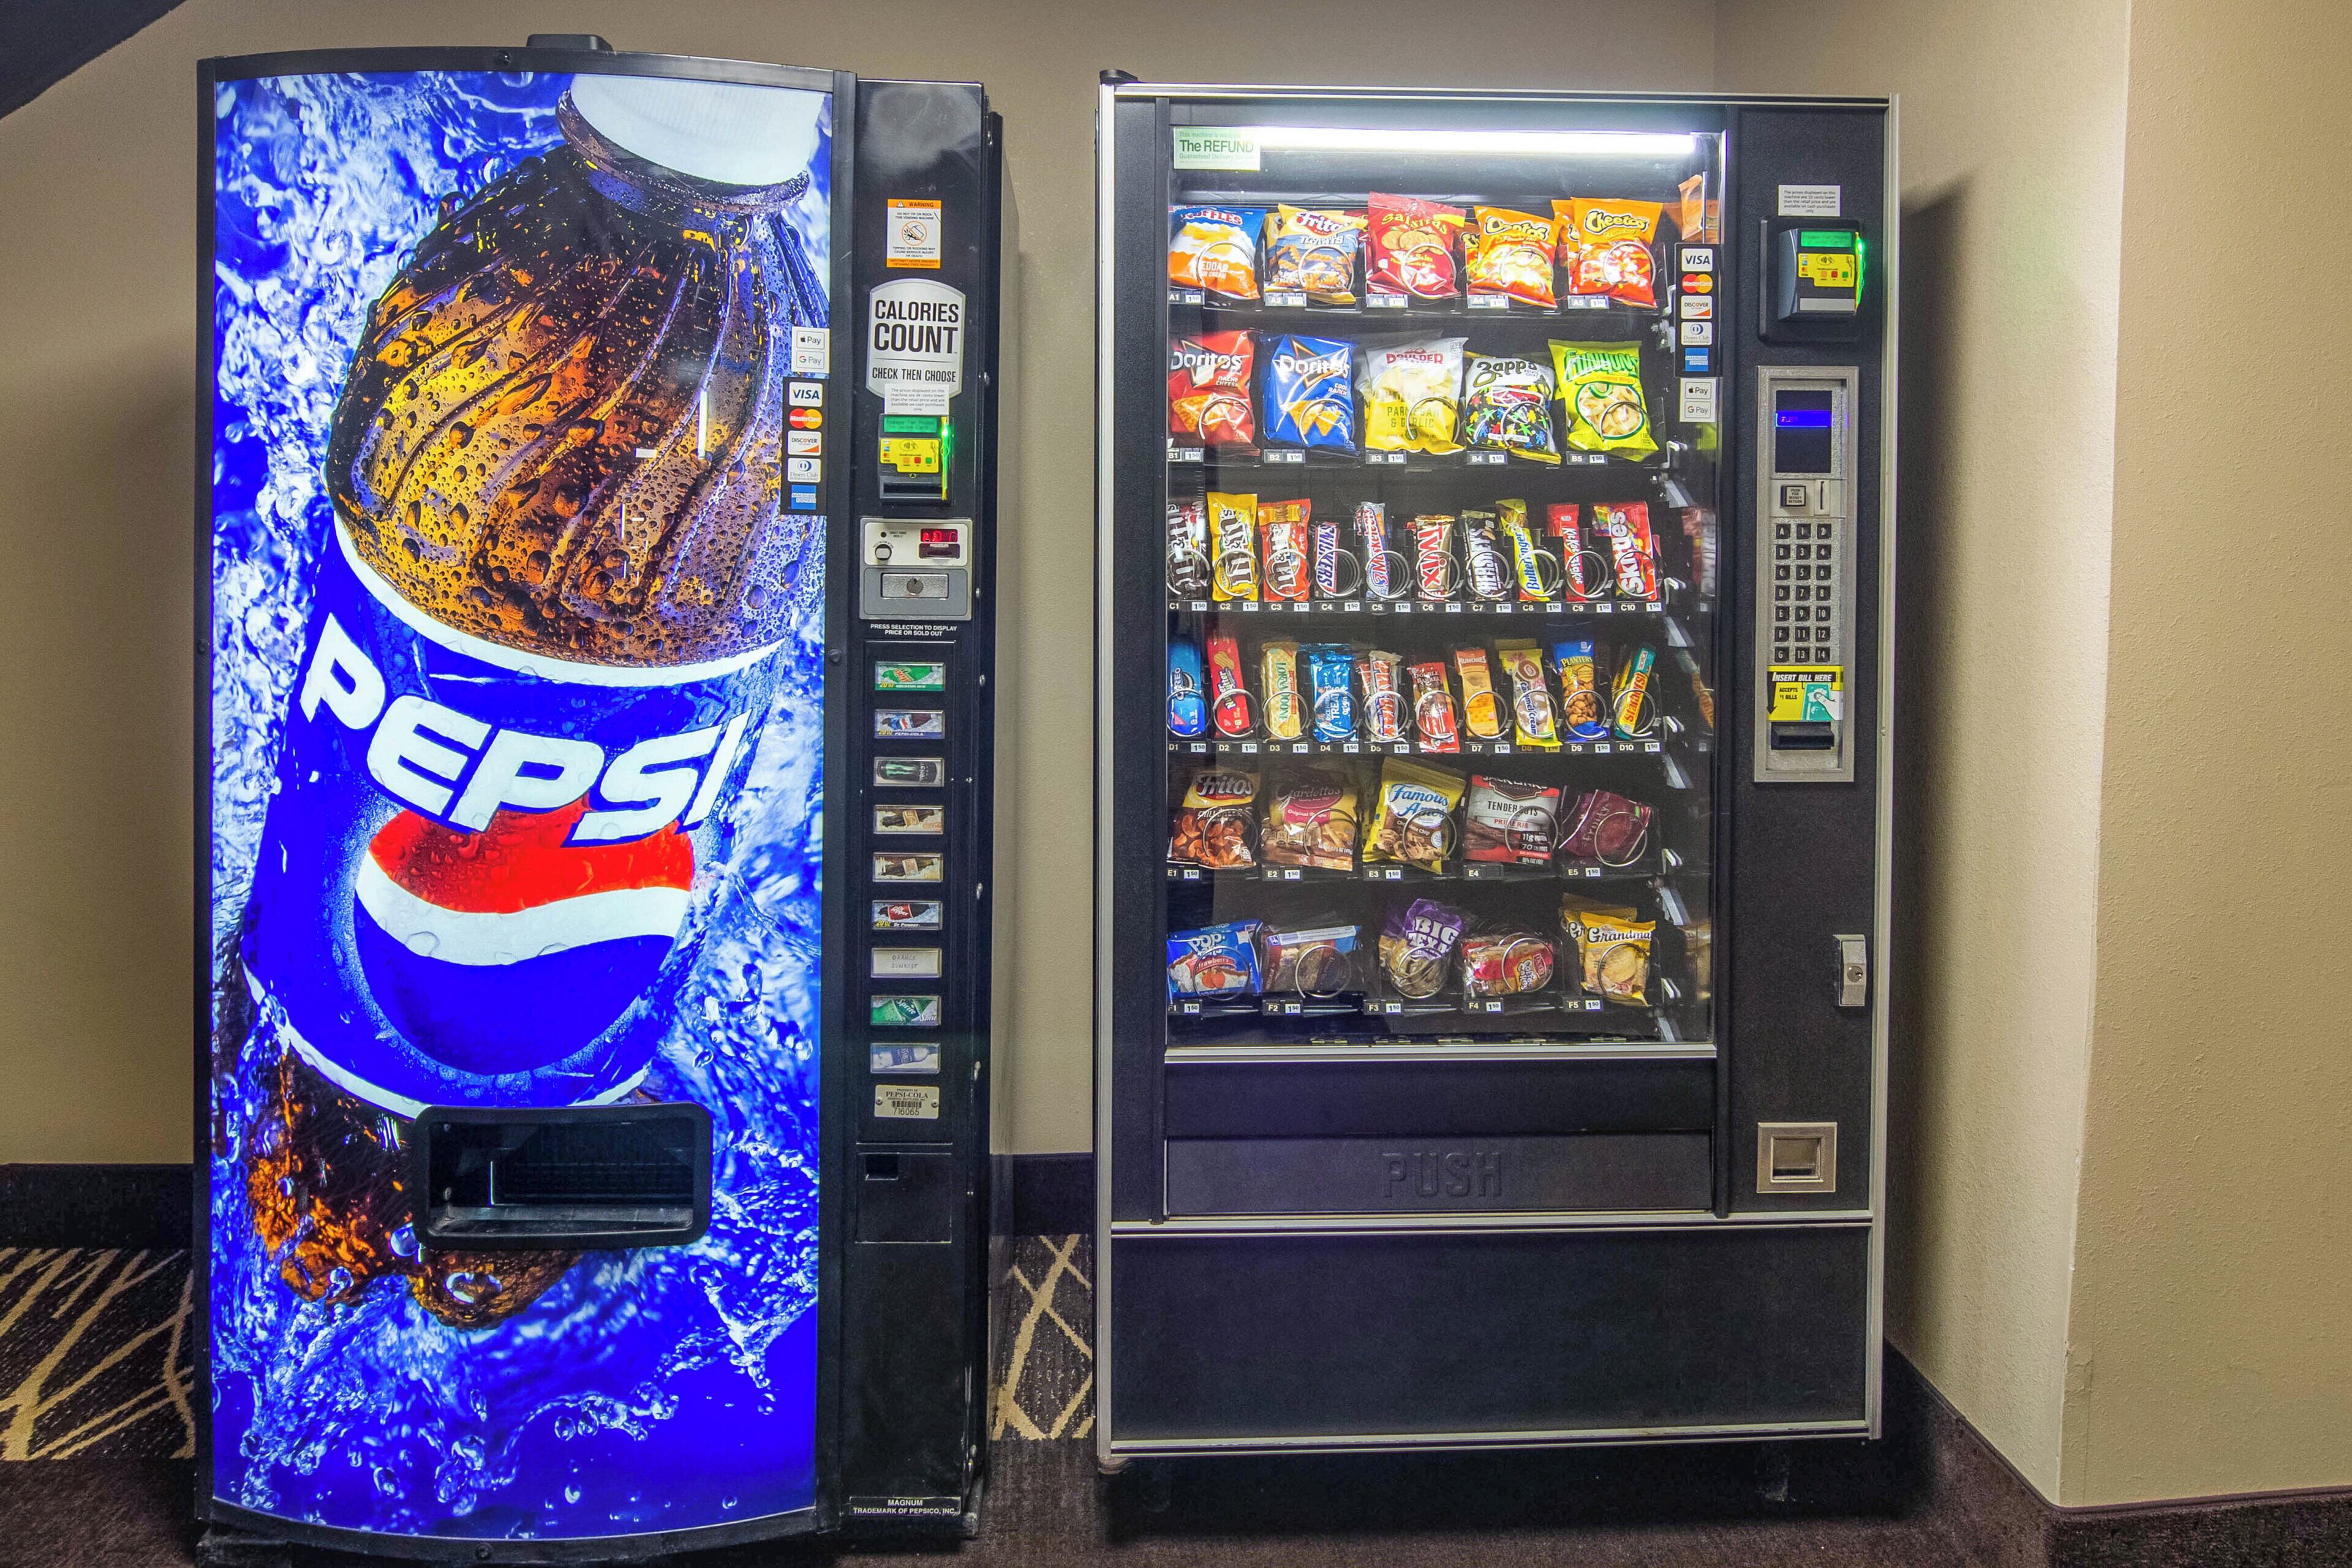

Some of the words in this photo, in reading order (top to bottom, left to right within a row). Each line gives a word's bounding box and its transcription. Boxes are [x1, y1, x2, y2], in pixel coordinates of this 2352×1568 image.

[1180, 140, 1201, 151] The
[1204, 140, 1254, 153] REFUND
[1585, 210, 1648, 233] Cheetos
[1685, 255, 1710, 264] VISA
[875, 300, 959, 323] CALORIES
[807, 336, 821, 345] Pay
[875, 323, 958, 354] COUNT
[808, 356, 821, 365] Pay
[1170, 352, 1243, 371] Doritos
[1280, 355, 1350, 378] Doritos
[1386, 353, 1443, 364] BOULDER
[872, 367, 898, 379] CHECK
[902, 369, 921, 380] THEN
[925, 371, 956, 382] CHOOSE
[793, 390, 820, 399] VISA
[1328, 387, 1348, 396] RANCH
[1317, 525, 1335, 588] SNICKERS
[1561, 656, 1593, 667] PLANTERS
[1172, 667, 1185, 701] OREO
[300, 612, 752, 842] PEPSI
[1196, 774, 1252, 796] Fritos
[1391, 784, 1449, 807] Famous
[1488, 801, 1518, 813] TENDER
[1414, 916, 1460, 944] BIG
[895, 998, 916, 1014] Sprite
[1382, 1152, 1501, 1198] PUSH
